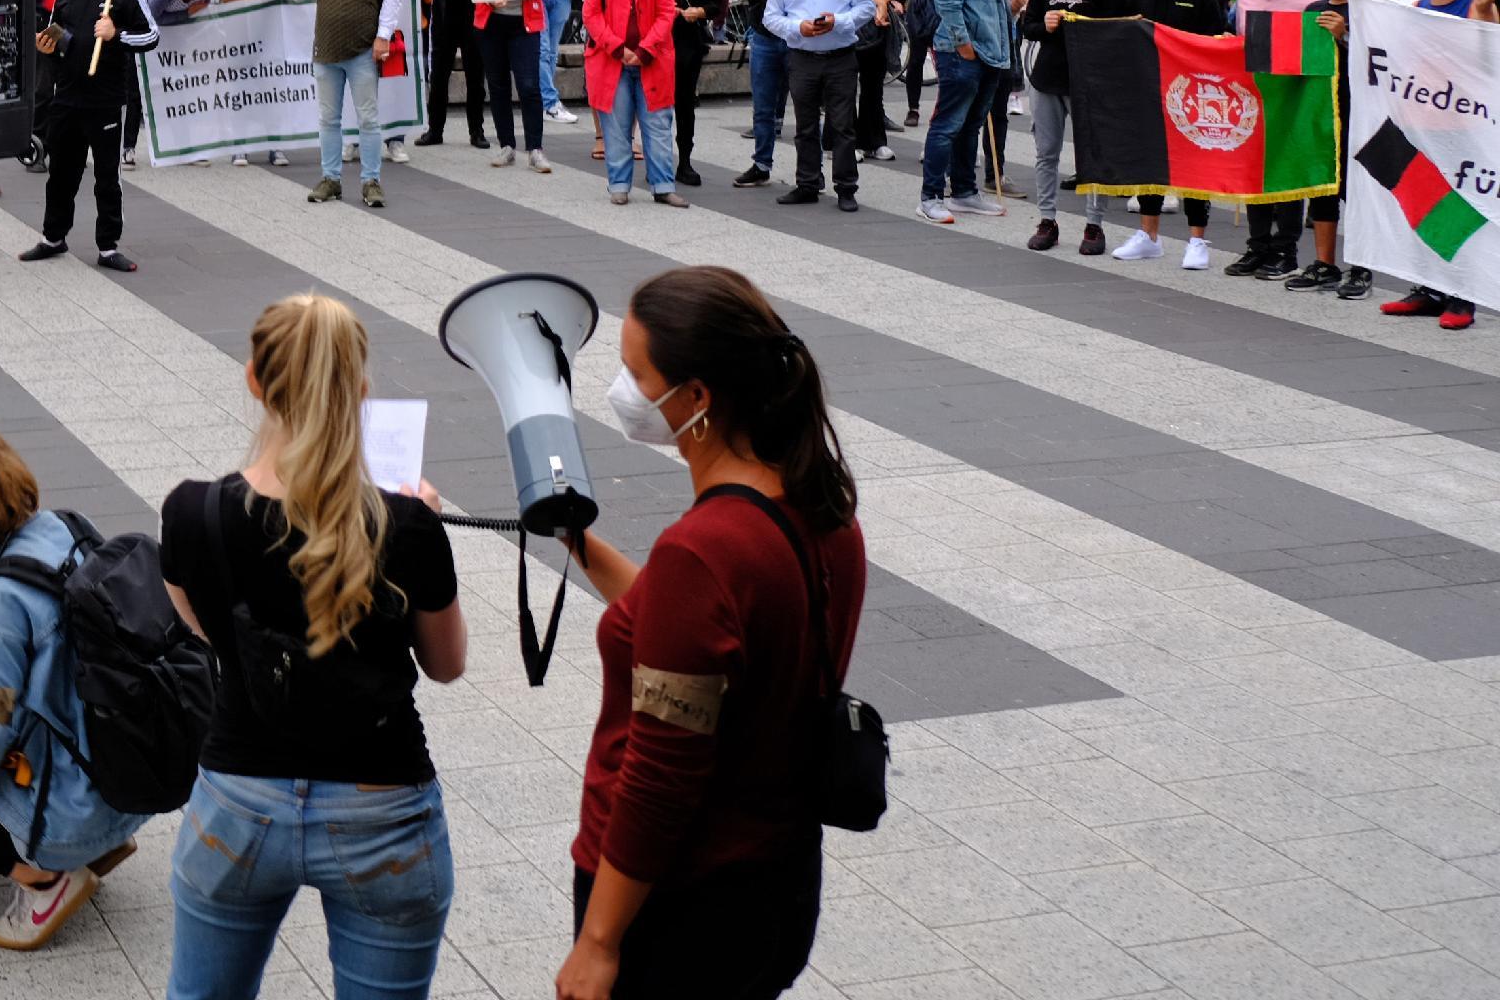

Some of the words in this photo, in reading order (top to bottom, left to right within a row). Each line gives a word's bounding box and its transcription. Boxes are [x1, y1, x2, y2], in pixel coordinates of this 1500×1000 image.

[157, 51, 186, 68] Wir
[192, 40, 264, 63] fordern:
[161, 72, 211, 93] Keine
[1367, 46, 1496, 125] Frieden,
[165, 97, 208, 119] nach
[213, 84, 317, 111] Afghanistan!
